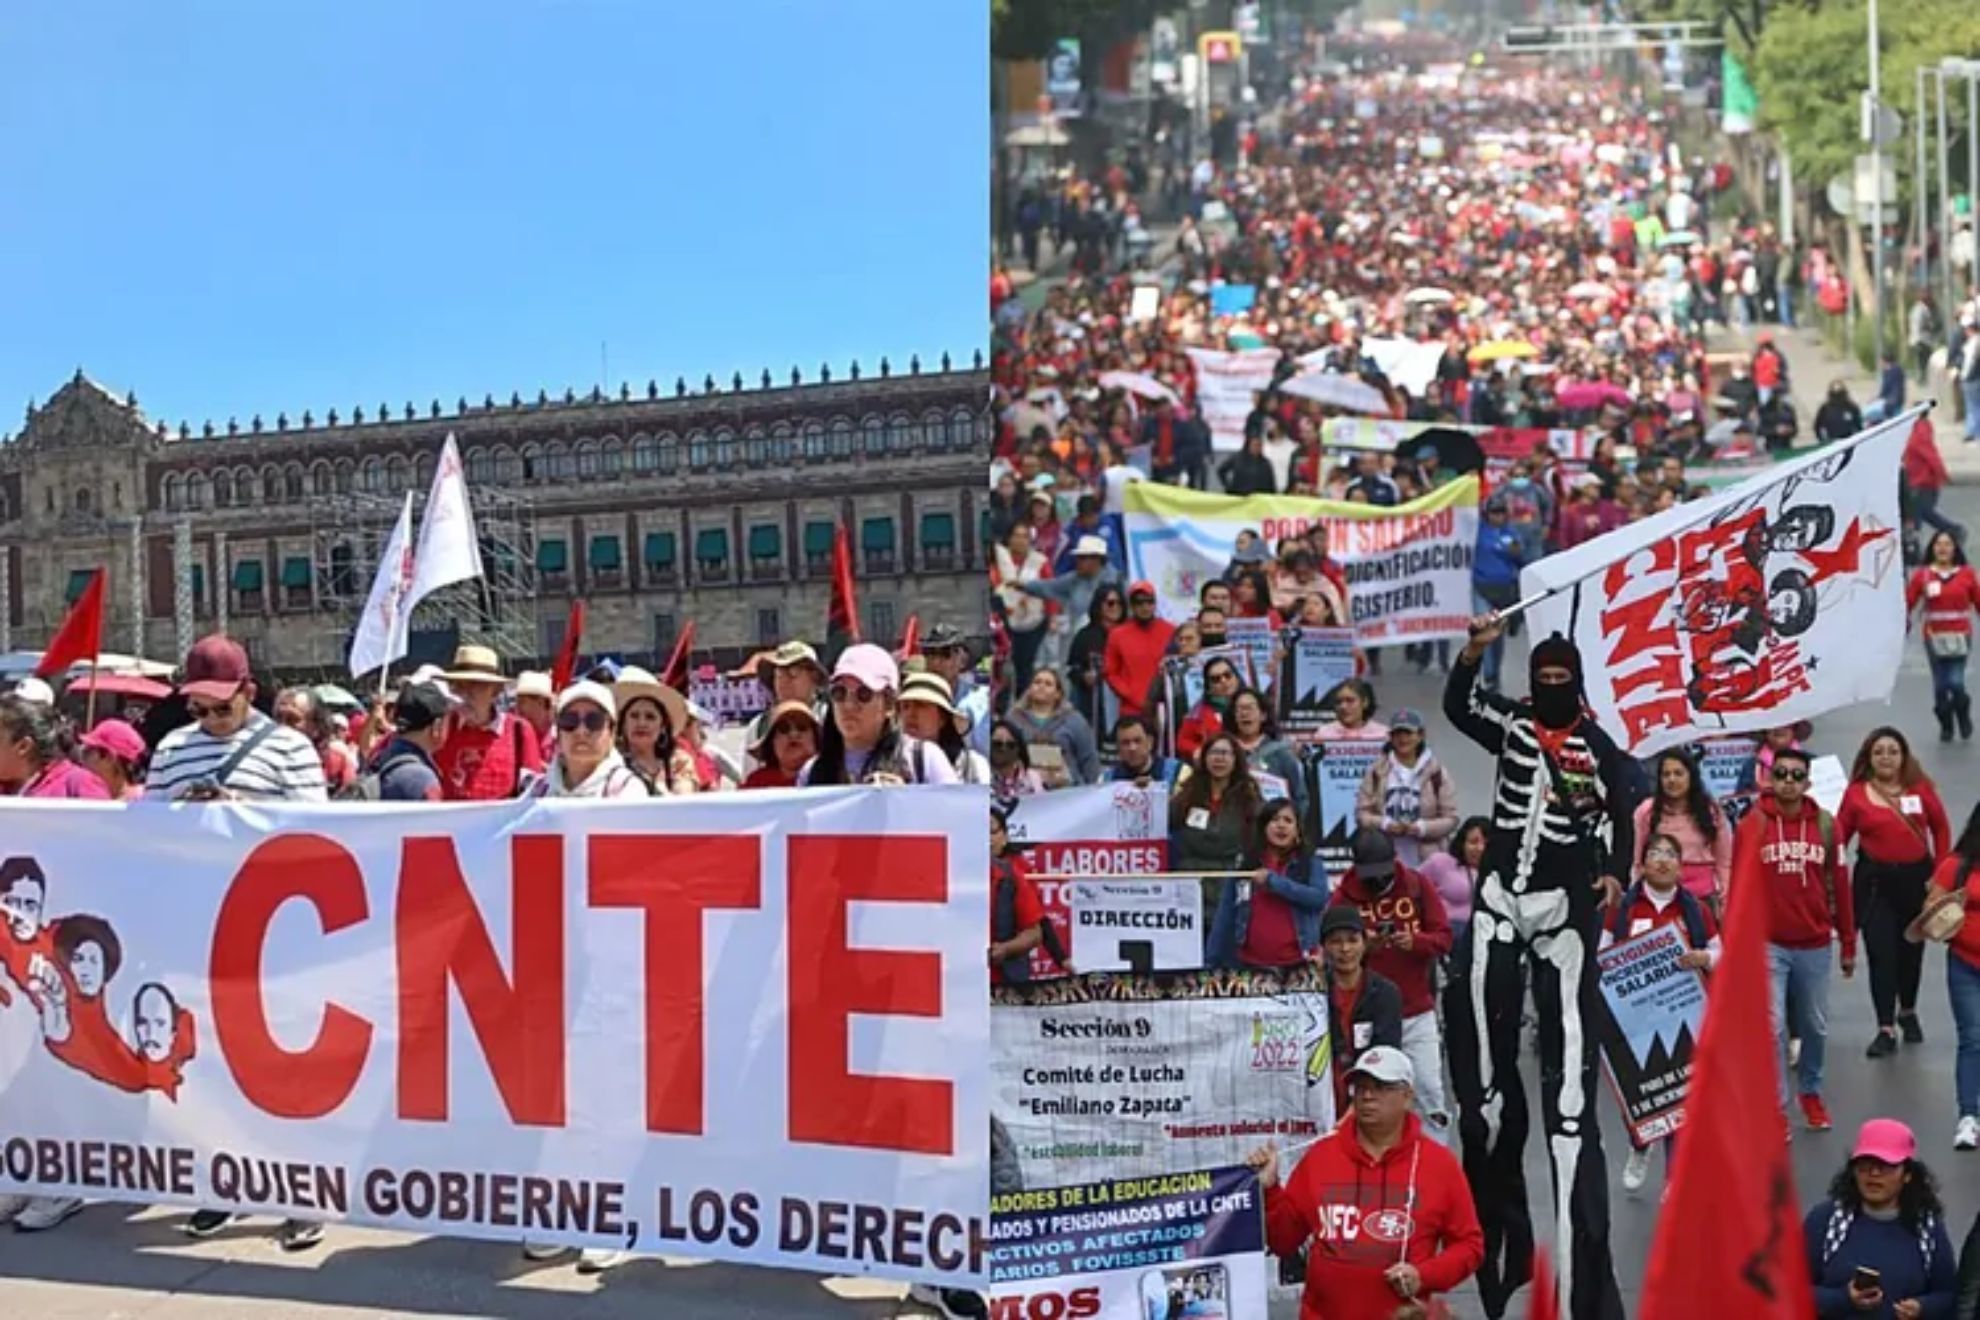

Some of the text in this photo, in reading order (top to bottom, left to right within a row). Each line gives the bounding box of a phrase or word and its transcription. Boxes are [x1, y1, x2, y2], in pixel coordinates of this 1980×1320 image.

[1356, 505, 1455, 553] SALARIO
[1601, 536, 1691, 750] CNTE
[1045, 847, 1160, 874] LABORES
[1078, 908, 1194, 931] DIRECCIÓN
[1602, 931, 1676, 970] EXIGIMOS
[1602, 944, 1683, 986] INCREMENTO
[208, 832, 955, 1156] CNTE
[1614, 962, 1680, 998] SALARIA
[1041, 1017, 1152, 1039] Sección 9
[1023, 1064, 1185, 1085] Comité de Lucha
[0, 1137, 194, 1194] OBIERNE
[210, 1152, 348, 1213] QUIEN
[363, 1168, 639, 1248] GOBIERNE,
[659, 1186, 760, 1248] LOS
[990, 1190, 1057, 1215] ADORES
[1062, 1187, 1082, 1207] DE
[1088, 1183, 1110, 1203] LA
[990, 1191, 1252, 1239] ADOS Y PENSIONADOS DE LA CNTE
[1318, 1203, 1360, 1240] NFC
[1082, 1222, 1206, 1249] AFECTADOS
[994, 1246, 1185, 1281] ARIOS FOVISSSTE
